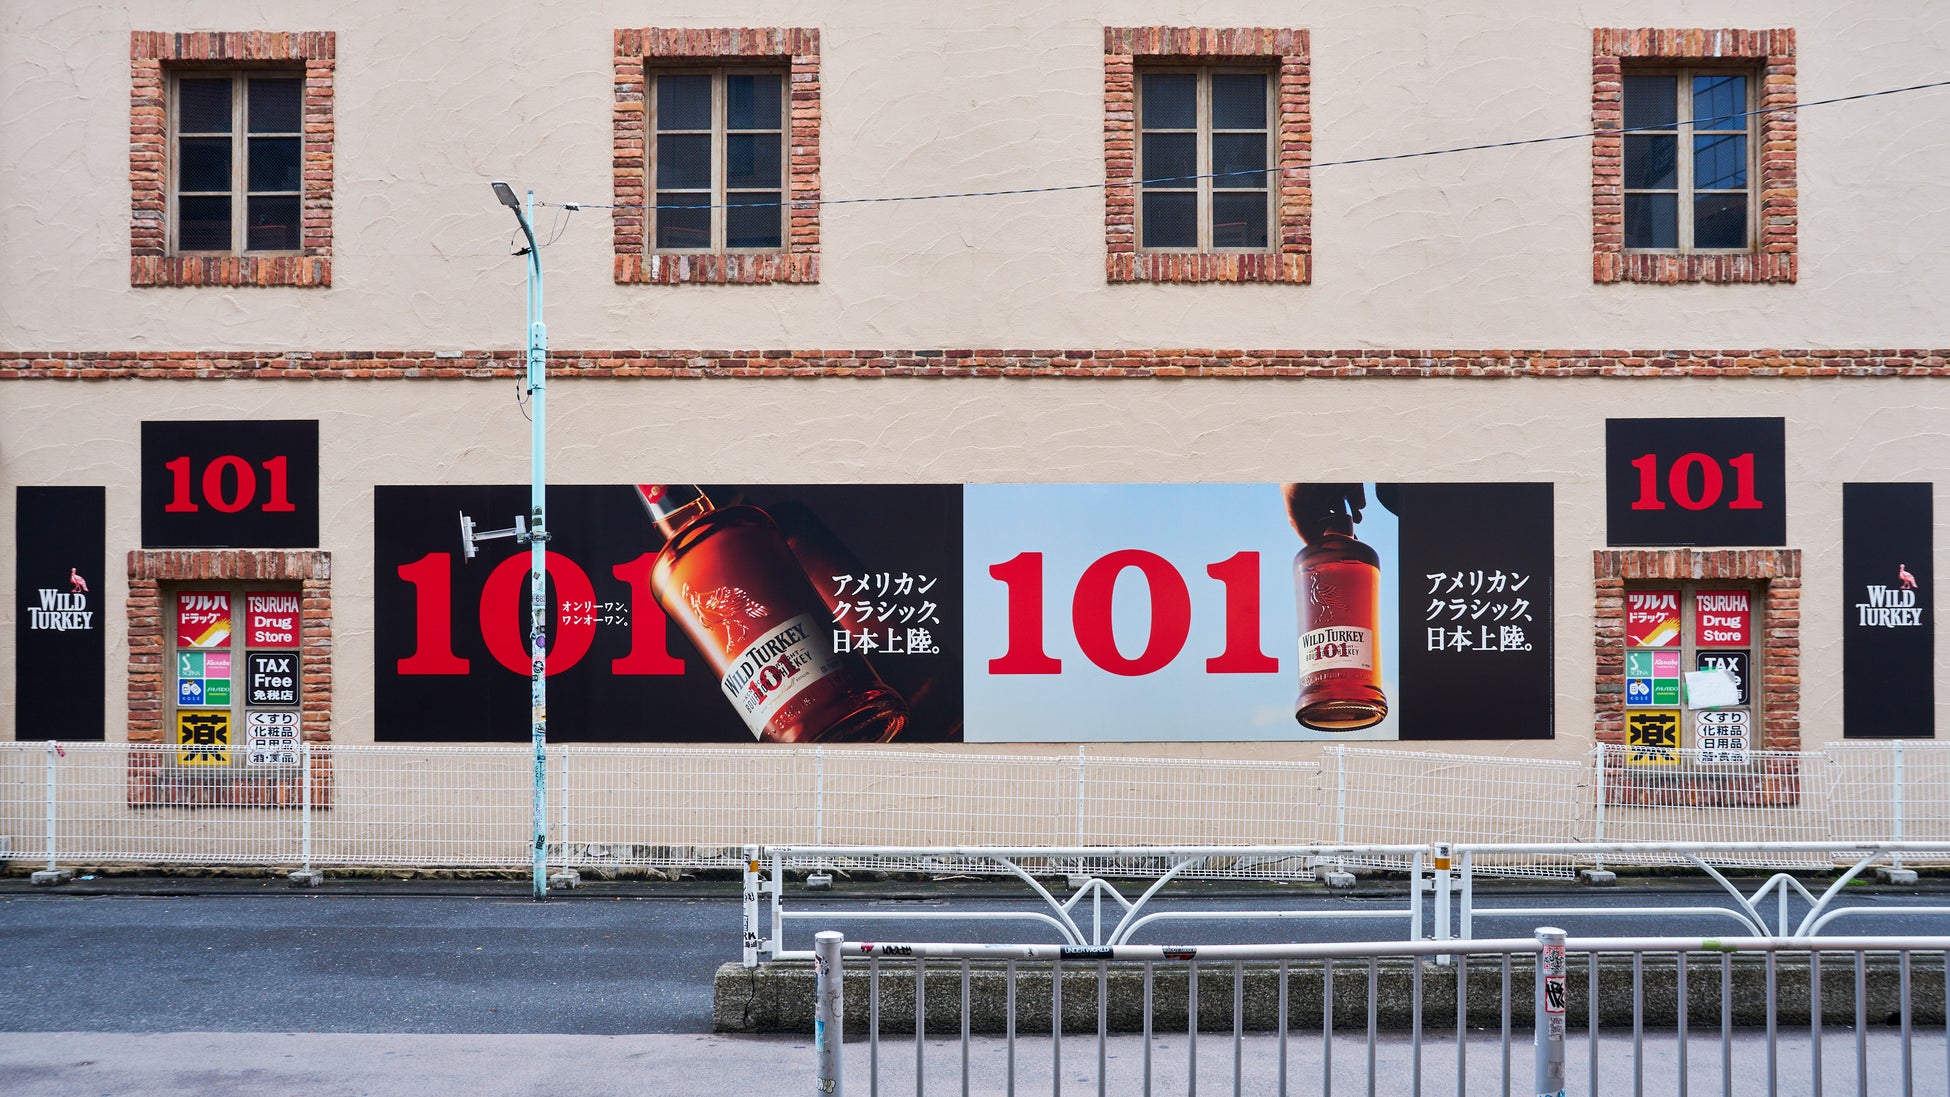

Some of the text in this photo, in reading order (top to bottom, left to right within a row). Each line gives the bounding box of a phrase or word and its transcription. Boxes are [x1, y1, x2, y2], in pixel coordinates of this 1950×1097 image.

[164, 455, 295, 513] 101
[1631, 452, 1763, 510] 101
[831, 572, 938, 598] アメリカン
[1425, 570, 1531, 596] アメリカン
[38, 588, 87, 611] WILD
[181, 595, 228, 611] ツルハ
[248, 597, 299, 613] TSURUHA
[1629, 595, 1677, 610] ツルハ
[1696, 596, 1749, 612] TSURUHA
[1866, 585, 1915, 608] WILD
[27, 607, 93, 631] TURKEY
[181, 613, 220, 624] ドラッグ
[397, 549, 685, 677] 101
[831, 600, 941, 624] クラシック、
[988, 548, 1279, 677] 101
[1425, 597, 1534, 623] クラシック、
[1629, 612, 1669, 623] ドラッグ
[1855, 603, 1923, 628] TURKEY
[254, 617, 292, 629] Drug
[1703, 615, 1741, 629] Drug
[255, 632, 292, 642] Store
[832, 627, 941, 655] 日本上陸。
[1302, 628, 1364, 648] WILD TURKEY
[1426, 624, 1534, 653] 日本上陸。
[1703, 630, 1741, 641] Store
[724, 662, 755, 698] WILD
[745, 623, 810, 670] TURKEY
[1315, 643, 1349, 661] 101
[256, 659, 290, 673] TAX
[1704, 657, 1739, 672] TAX
[254, 674, 292, 687] Free
[748, 653, 801, 706] 101
[254, 690, 293, 701] 免税店
[255, 714, 292, 723] くすり
[1703, 712, 1742, 723] くすり
[182, 714, 227, 761] 薬
[255, 726, 293, 737] 化粧品
[1630, 714, 1676, 761] 薬
[1703, 725, 1742, 736] 化粧品
[1704, 738, 1742, 749] 日用品
